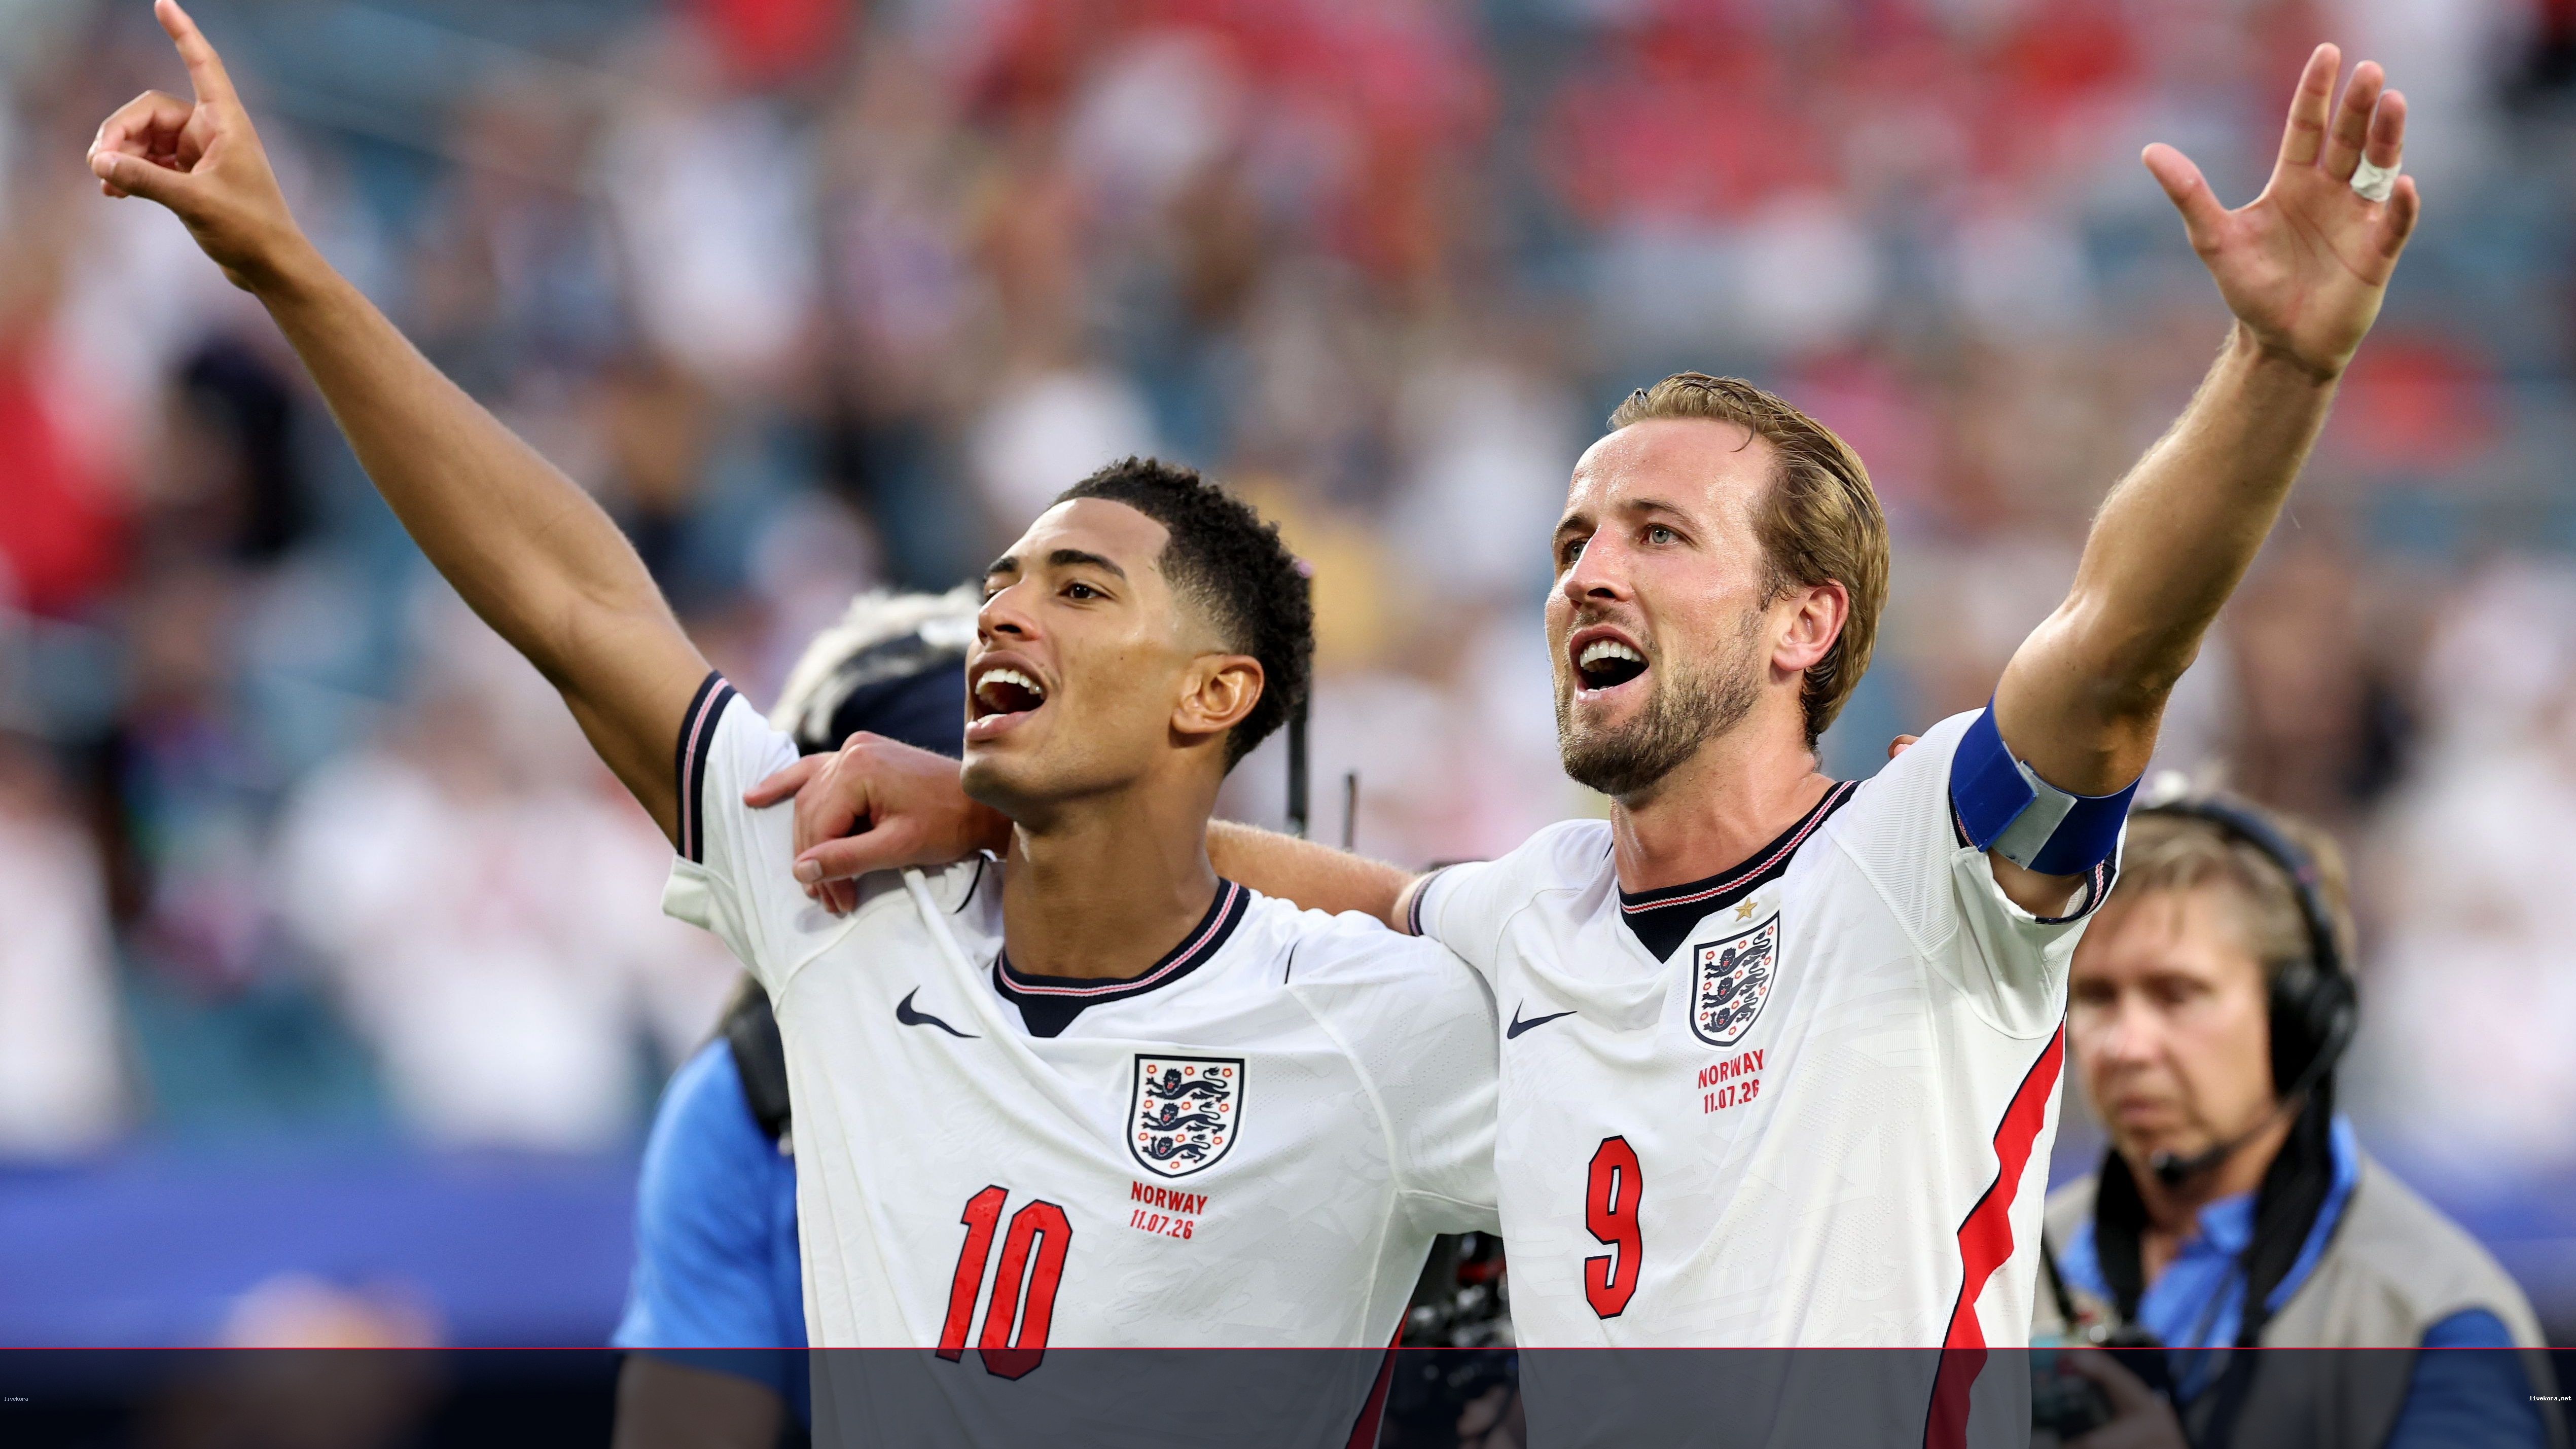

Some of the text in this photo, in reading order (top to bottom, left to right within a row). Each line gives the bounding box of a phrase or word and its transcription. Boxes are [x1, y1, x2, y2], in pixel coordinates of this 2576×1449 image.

[1698, 1049, 1763, 1089] NORWAY
[1703, 1079, 1759, 1114] 11.07.26
[1131, 1181, 1208, 1215] NORWAY
[1130, 1209, 1194, 1240] 11.07.26
[1584, 1135, 1643, 1320] 9
[935, 1184, 1072, 1381] 10
